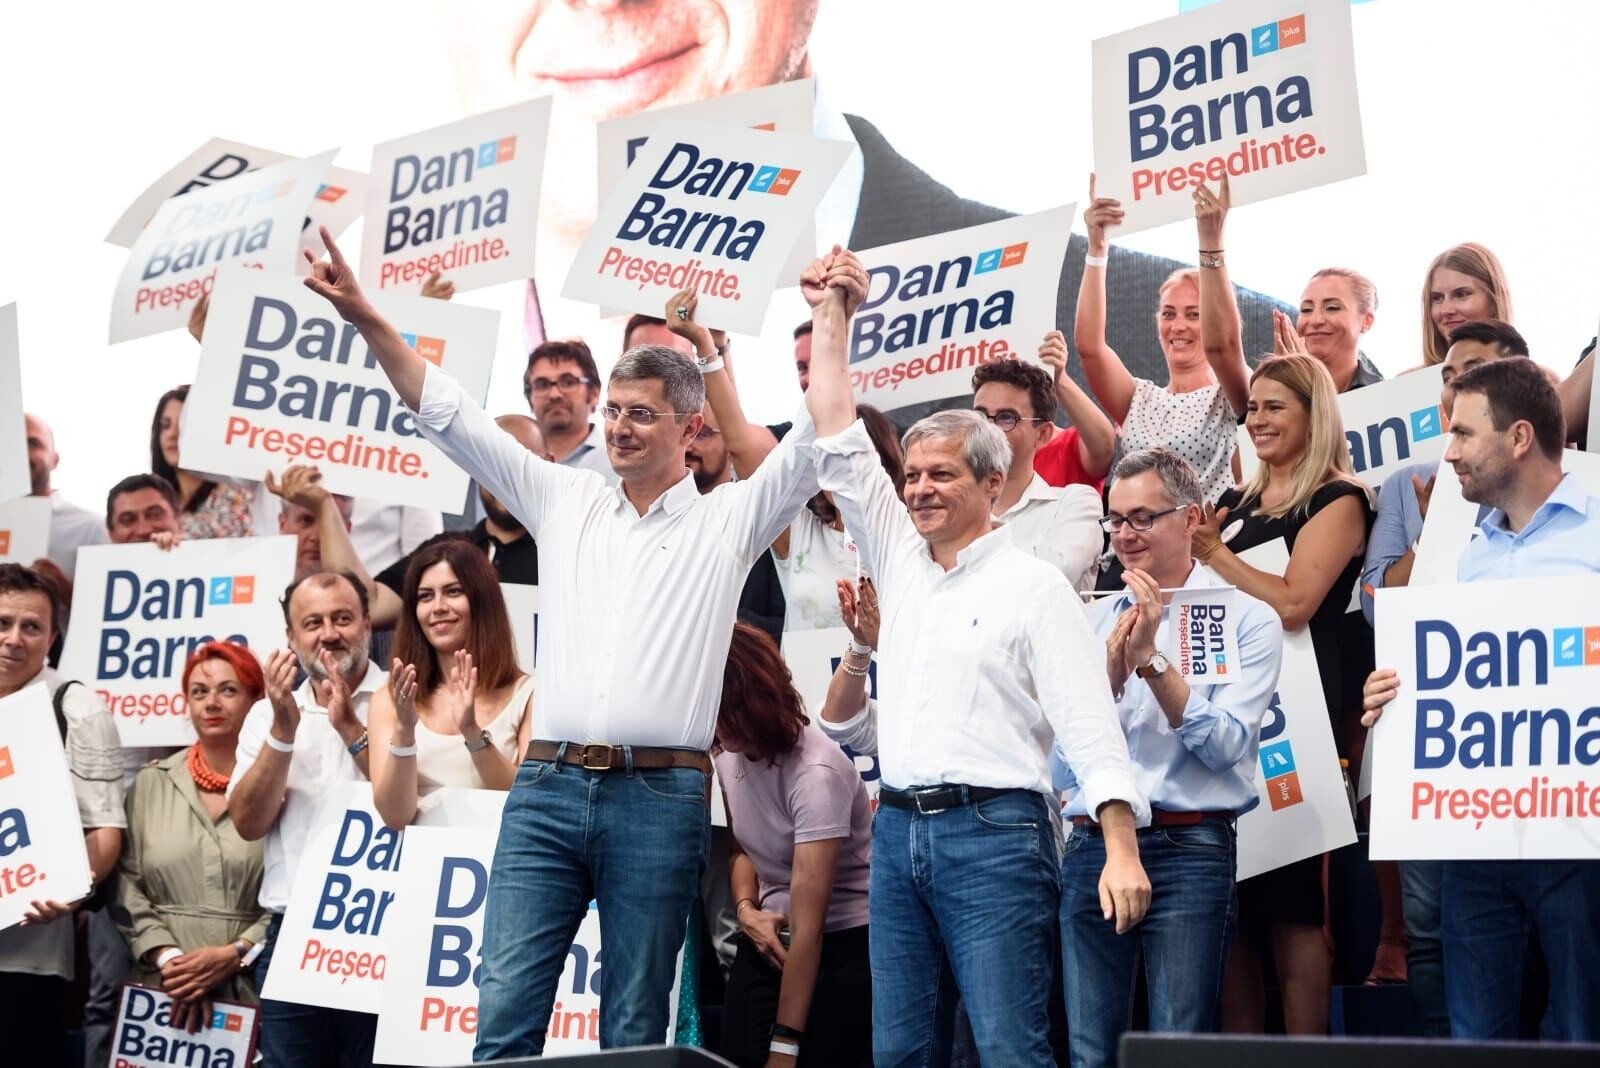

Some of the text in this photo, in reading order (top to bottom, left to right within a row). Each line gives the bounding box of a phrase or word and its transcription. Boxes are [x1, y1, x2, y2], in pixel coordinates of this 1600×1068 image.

[1127, 32, 1249, 104] Dan
[1128, 74, 1314, 163] Barna
[389, 145, 476, 204] Dan
[647, 142, 756, 200] Dan
[140, 217, 275, 283] Barna
[382, 186, 511, 255] Barna
[615, 192, 766, 262] Barna
[856, 255, 973, 312] Dan
[849, 289, 1015, 364] Barna
[224, 416, 430, 479] Președinte.
[103, 569, 205, 622] Dan
[1191, 604, 1208, 676] Barna
[1209, 604, 1226, 653] Dan
[1414, 619, 1549, 691] Dan
[330, 809, 400, 872] Da
[118, 1022, 236, 1068] Barna
